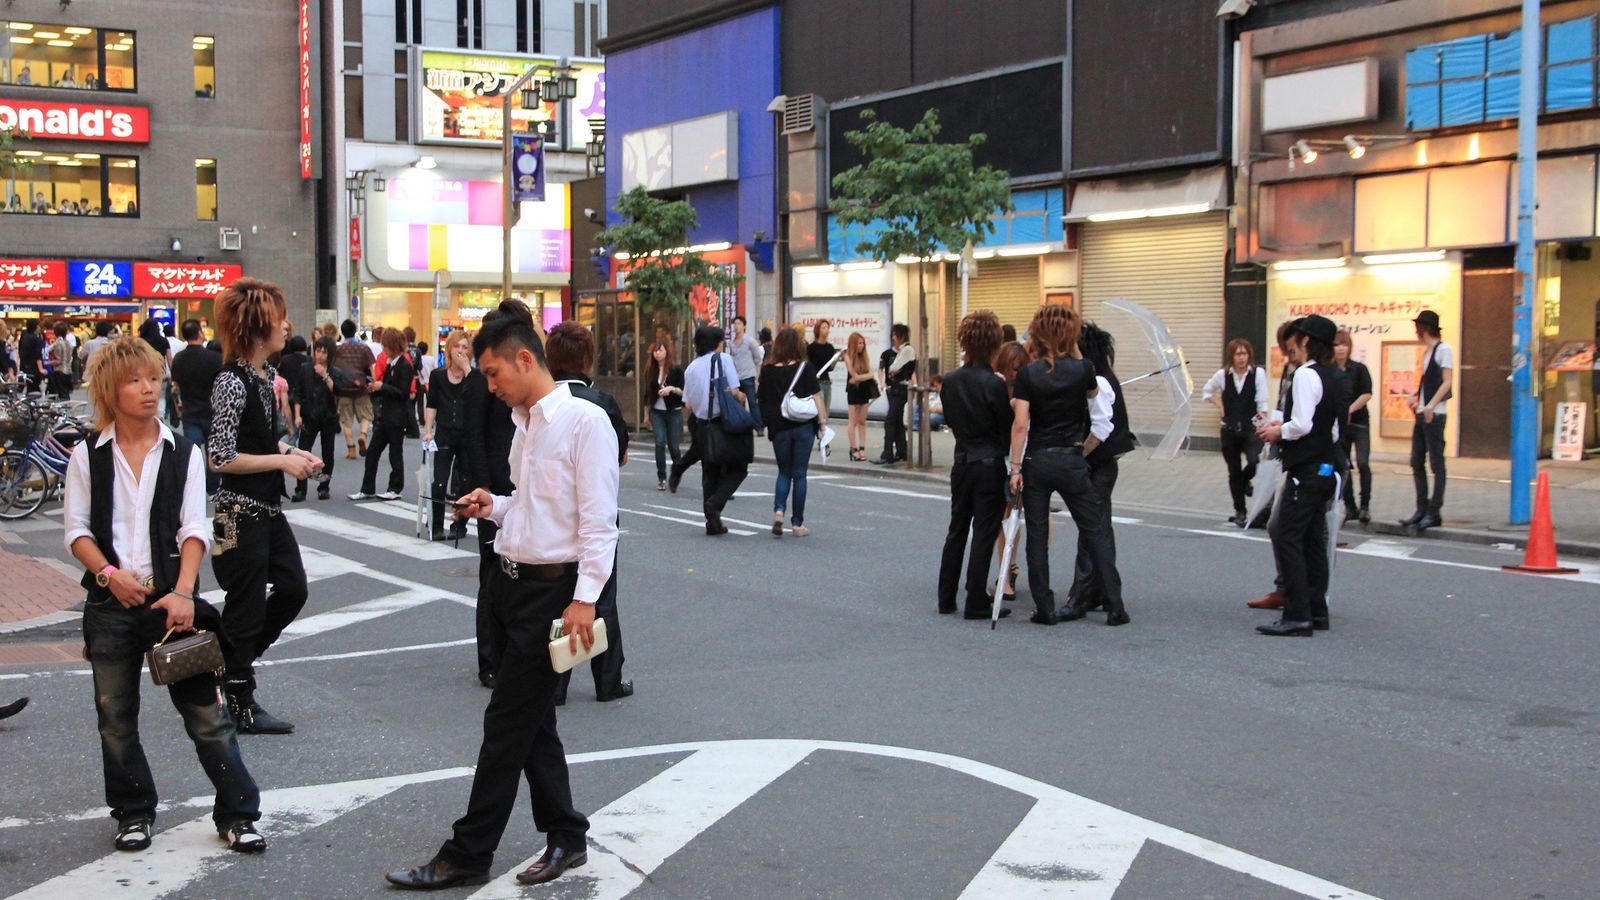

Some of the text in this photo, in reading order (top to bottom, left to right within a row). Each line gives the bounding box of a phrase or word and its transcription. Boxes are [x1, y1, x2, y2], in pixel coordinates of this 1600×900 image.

[0, 105, 133, 138] onald's
[148, 267, 225, 281] マクドナルド
[84, 283, 118, 295] OPEN
[152, 281, 226, 295] ハンバーガー
[1289, 300, 1431, 316] KABUKICHO ウォールギャラリー
